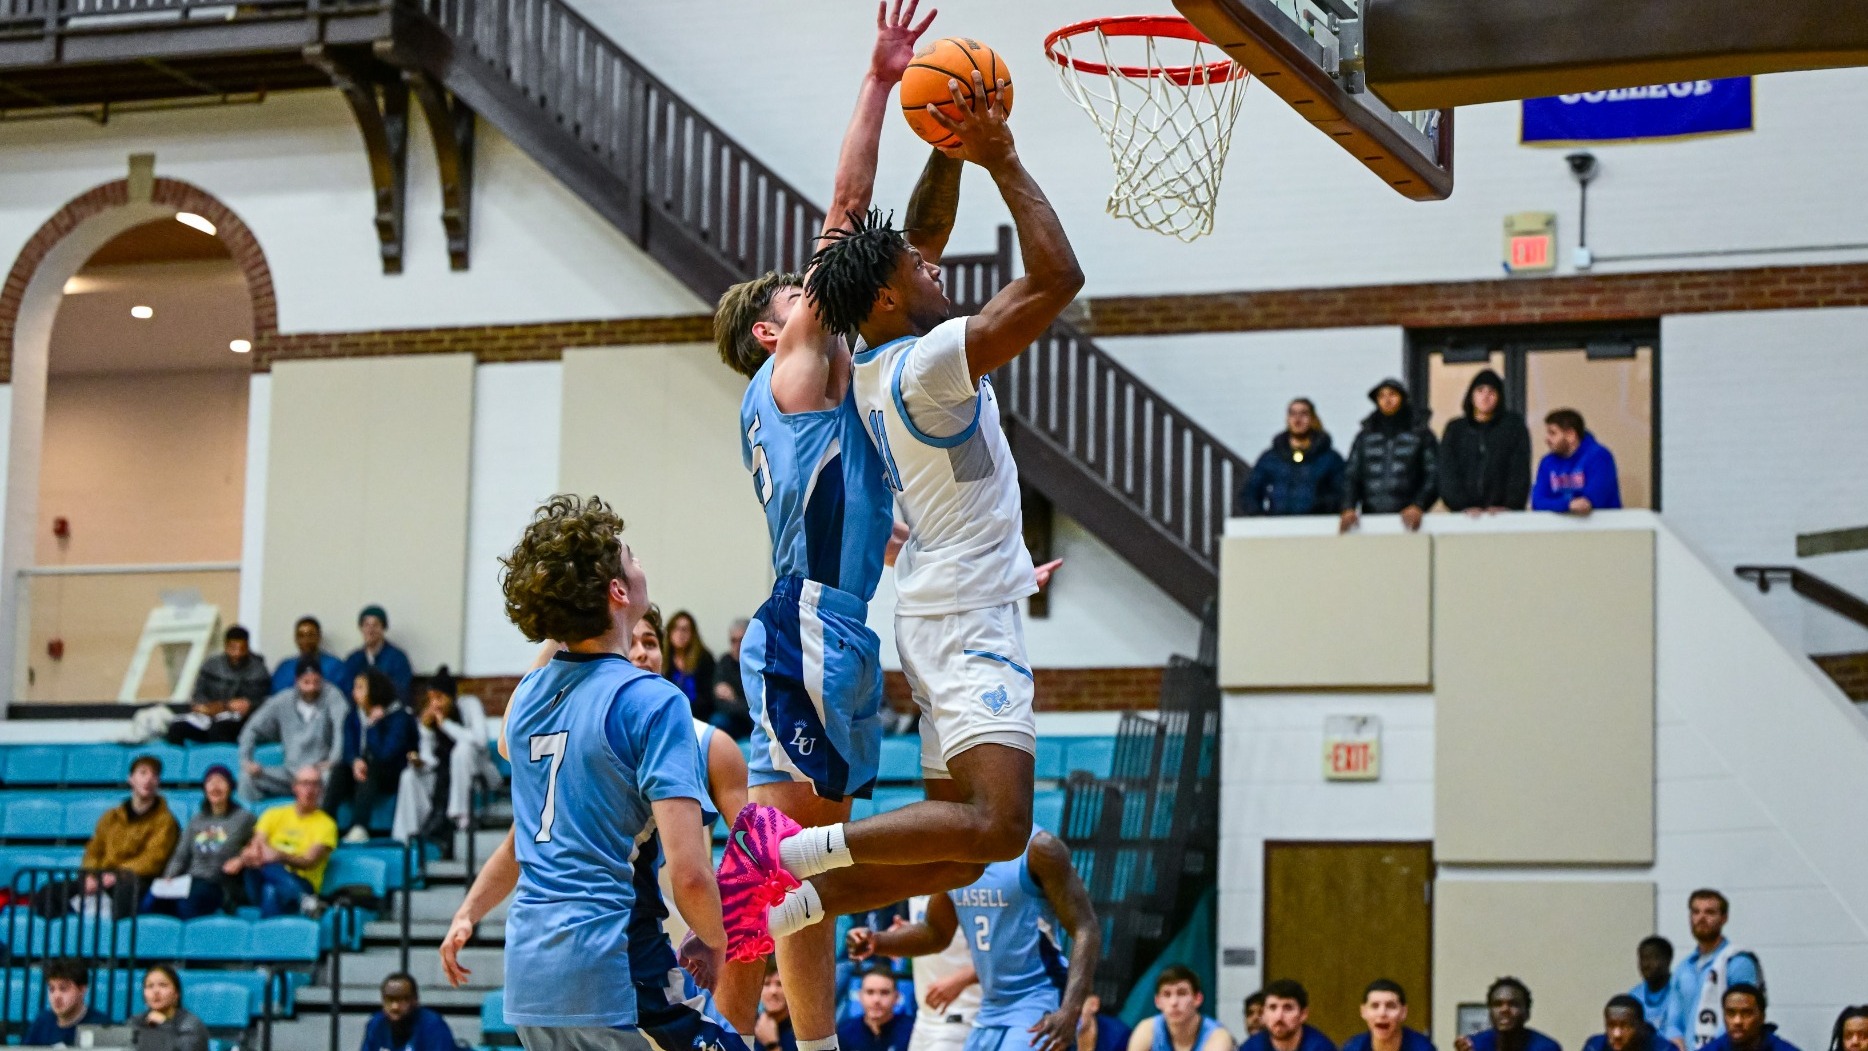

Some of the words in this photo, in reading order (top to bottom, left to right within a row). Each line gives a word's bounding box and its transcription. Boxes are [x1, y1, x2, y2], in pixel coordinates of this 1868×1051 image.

[1511, 236, 1548, 265] EXIT
[747, 410, 773, 510] 5
[868, 409, 904, 492] 11
[1332, 743, 1369, 773] EXIT
[528, 730, 569, 844] 7
[952, 888, 1009, 908] LASELL
[974, 914, 991, 952] 2
